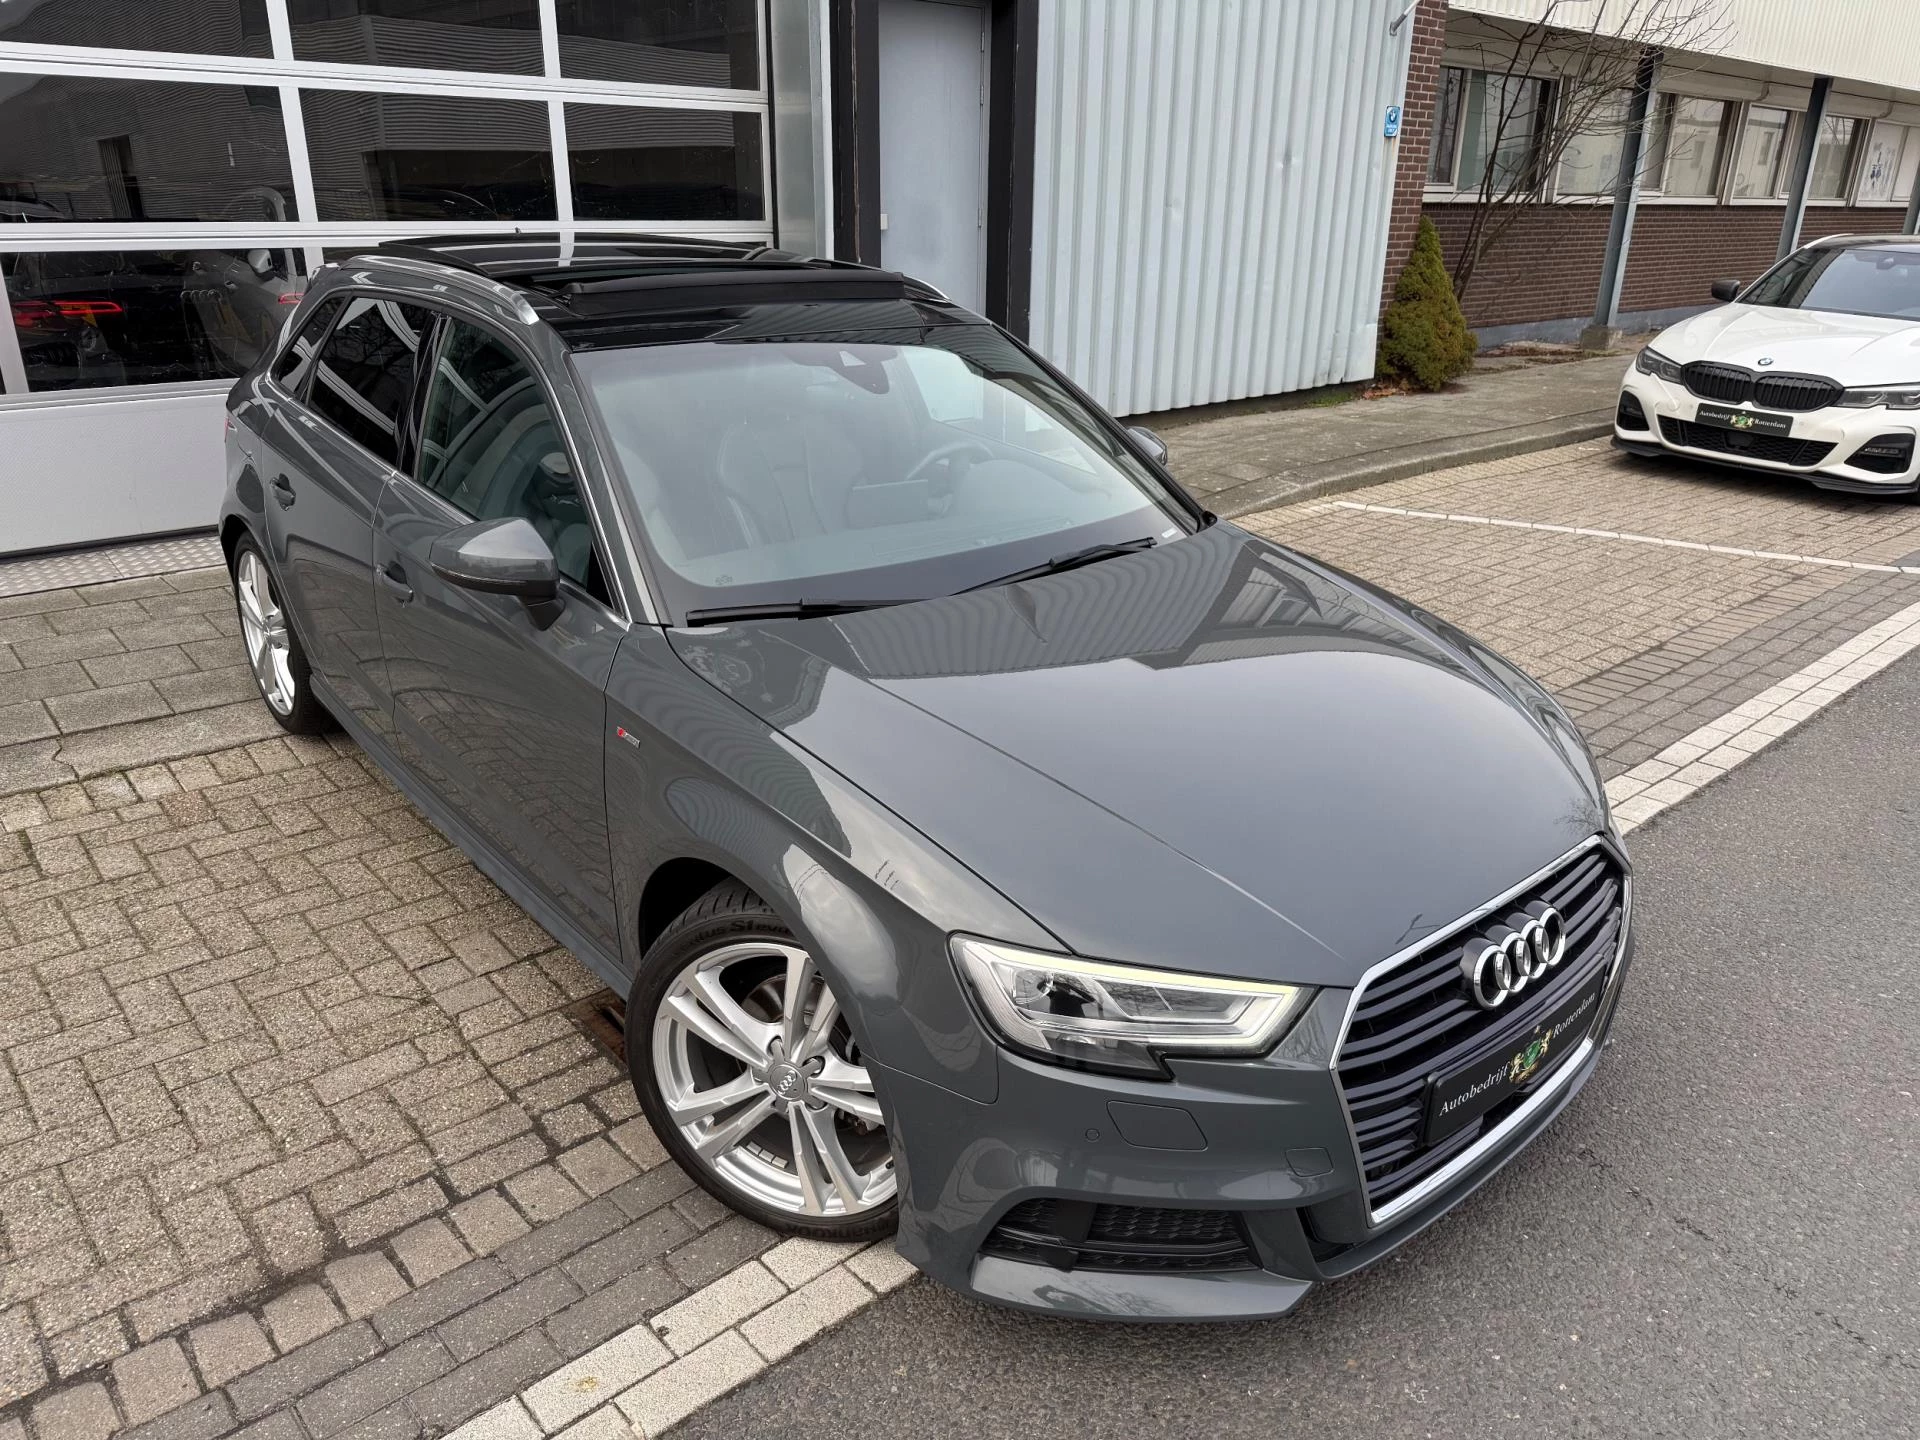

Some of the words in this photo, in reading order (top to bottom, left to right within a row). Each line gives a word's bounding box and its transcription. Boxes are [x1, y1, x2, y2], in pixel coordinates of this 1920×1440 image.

[1755, 418, 1786, 429] Rotterdam
[1439, 1061, 1510, 1117] Autobedrijf
[1553, 993, 1596, 1039] Rotterdam
